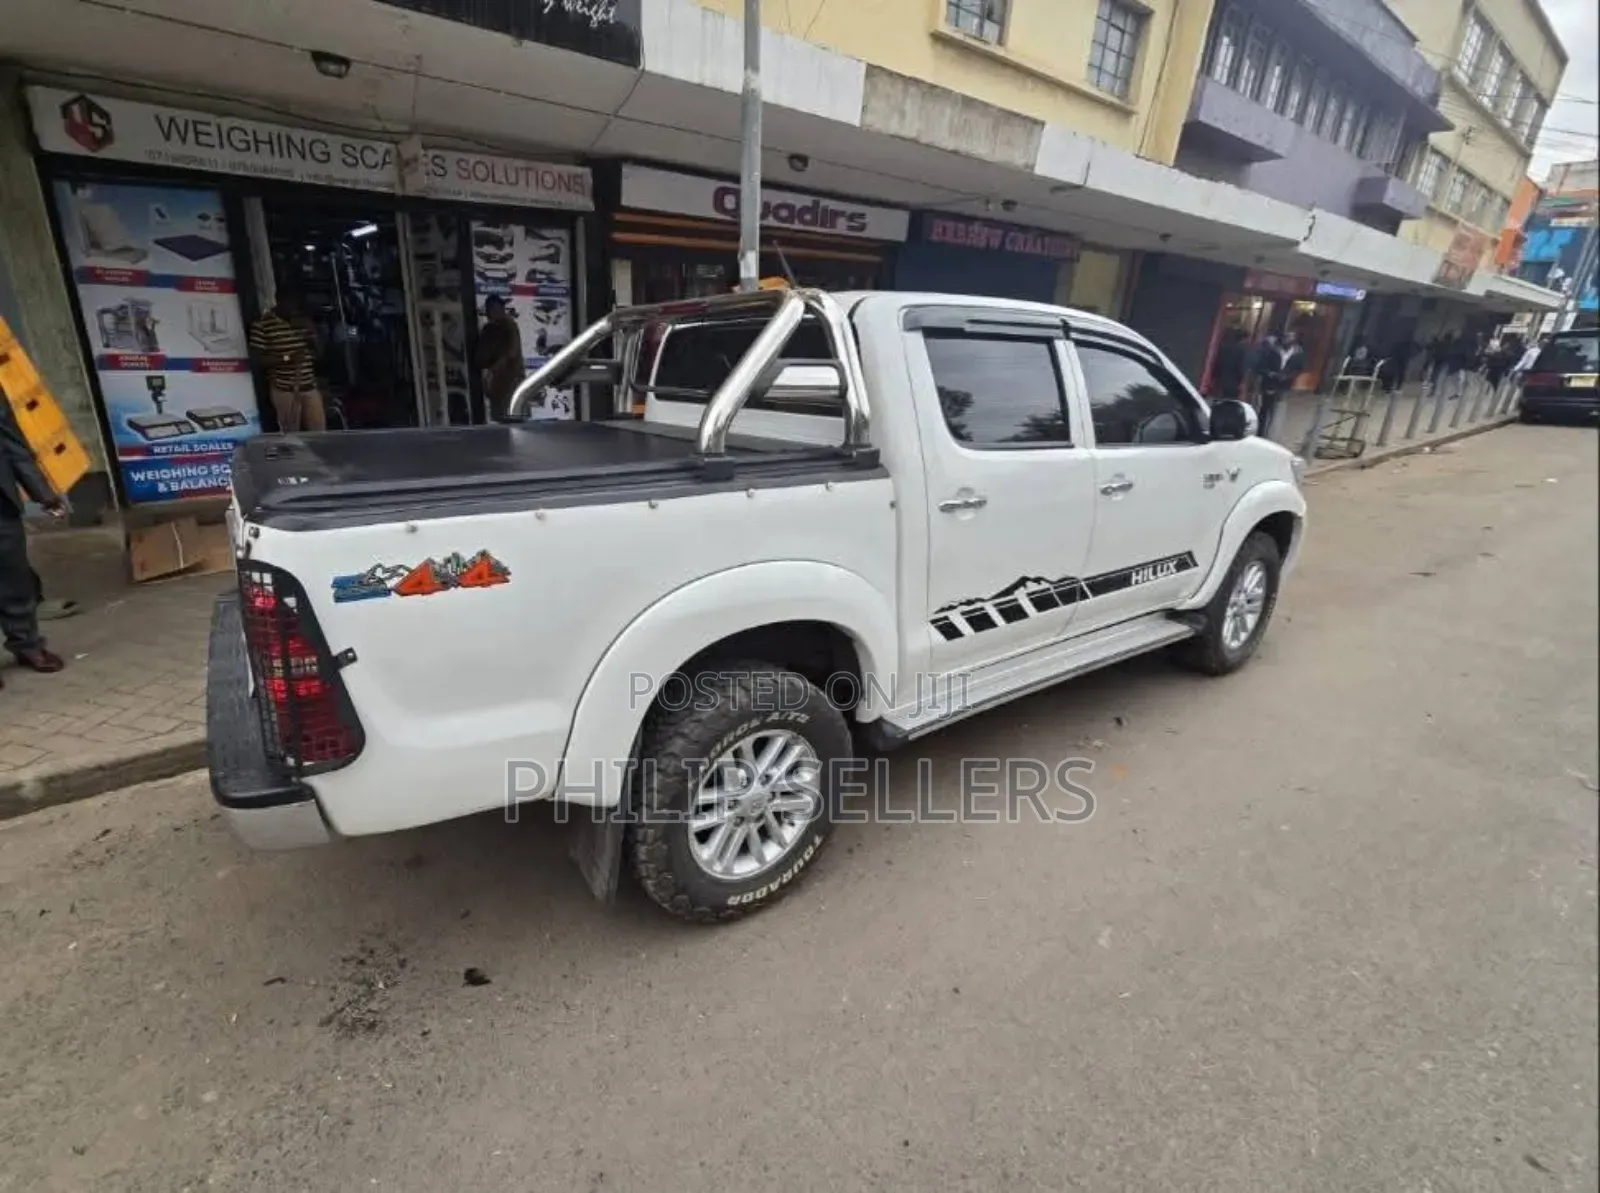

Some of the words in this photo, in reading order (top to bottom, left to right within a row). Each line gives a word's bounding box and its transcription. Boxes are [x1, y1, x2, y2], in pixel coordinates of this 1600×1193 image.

[154, 114, 330, 163] WEIGHING
[341, 142, 448, 177] SCAS
[456, 158, 586, 196] SOLUTIONS
[153, 444, 191, 454] RETAIL
[193, 442, 234, 451] SCALES
[131, 465, 208, 482] WEIGHING
[1131, 559, 1180, 586] HILUX
